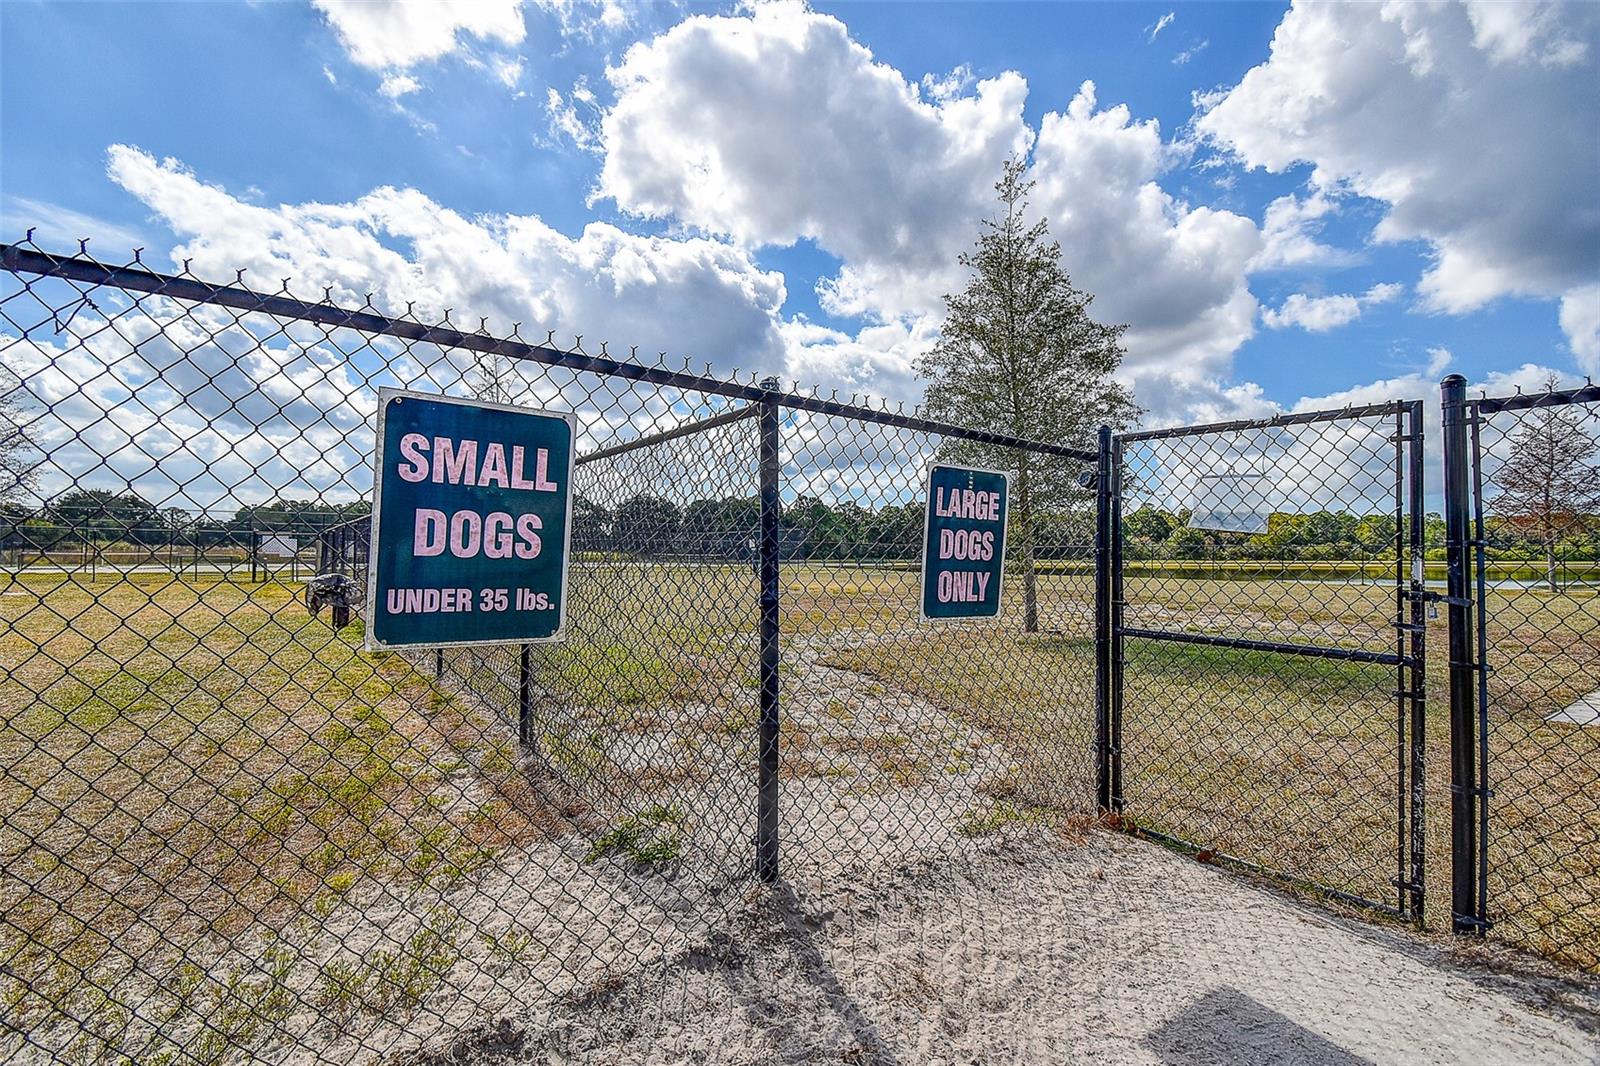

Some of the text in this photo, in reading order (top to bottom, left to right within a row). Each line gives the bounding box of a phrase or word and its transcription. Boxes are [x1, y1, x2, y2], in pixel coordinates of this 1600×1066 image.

[398, 433, 557, 492] SMALL
[935, 486, 1000, 521] LARGE
[413, 508, 543, 560] DOGS
[939, 528, 994, 561] DOGS
[387, 588, 555, 614] UNDER 35 lbs.
[937, 570, 991, 603] ONLY
